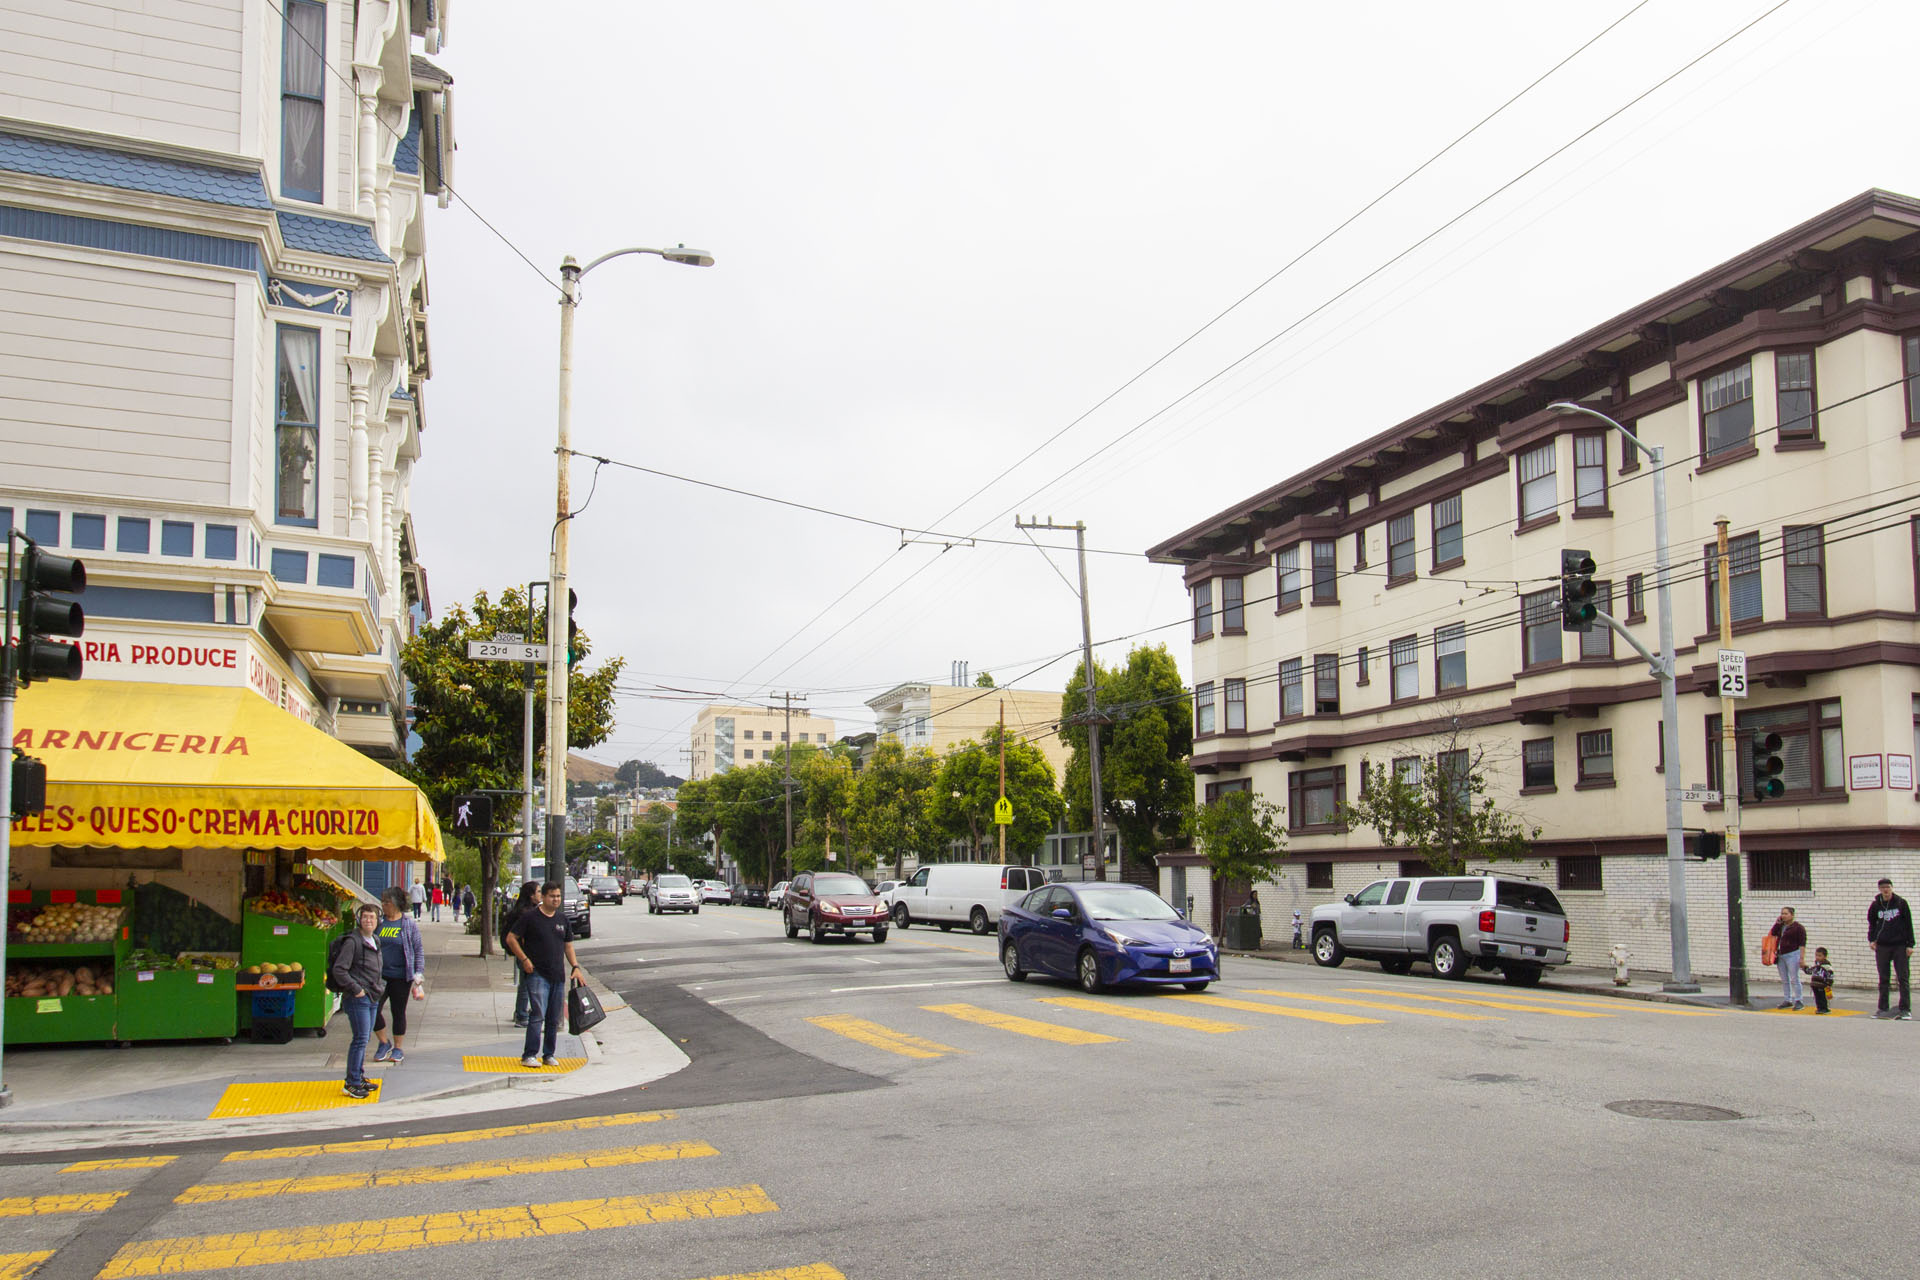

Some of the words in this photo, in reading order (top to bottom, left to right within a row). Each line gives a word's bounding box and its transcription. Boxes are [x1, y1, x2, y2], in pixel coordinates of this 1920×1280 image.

[497, 634, 516, 642] 3200
[131, 644, 237, 669] PRODUCE
[480, 645, 508, 656] 23rd
[525, 647, 540, 658] St
[1720, 654, 1744, 664] SPEED
[1723, 664, 1741, 673] LIMIT
[1722, 674, 1745, 692] 25
[12, 728, 250, 756] ARNICERIA
[1707, 792, 1715, 800] St
[90, 805, 177, 836] QUESO
[188, 807, 281, 837] CREMA
[287, 808, 380, 837] CHORIZO
[378, 926, 402, 938] NIKE
